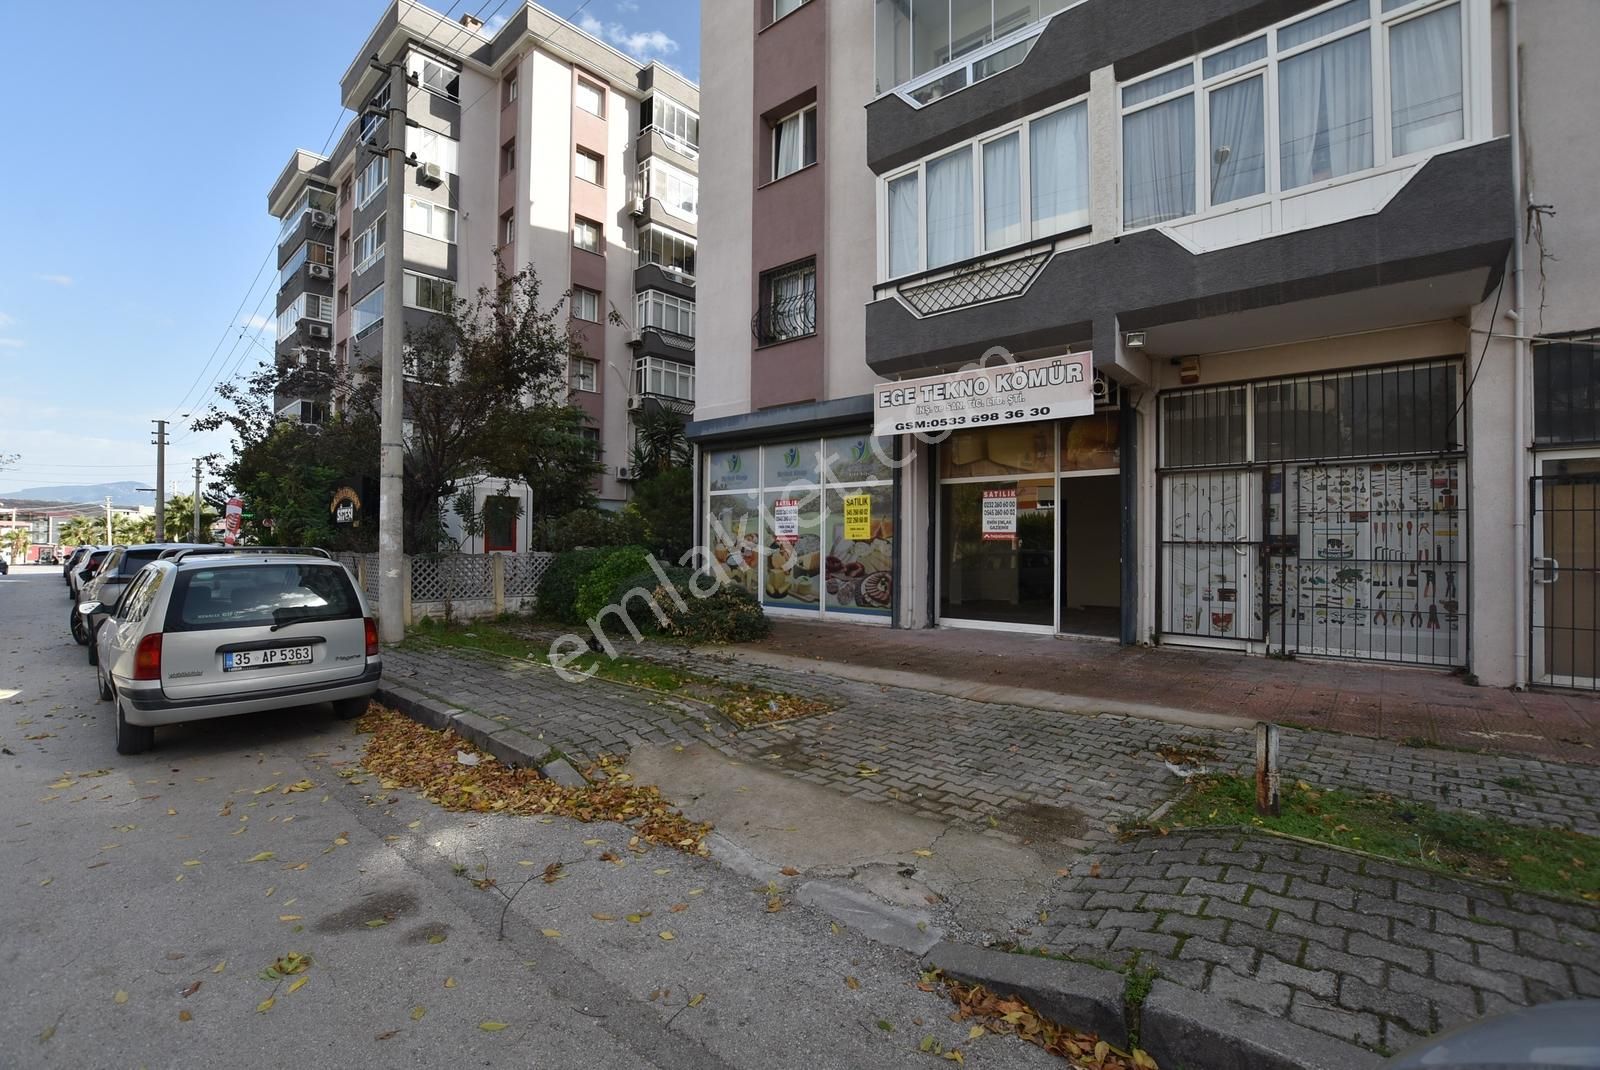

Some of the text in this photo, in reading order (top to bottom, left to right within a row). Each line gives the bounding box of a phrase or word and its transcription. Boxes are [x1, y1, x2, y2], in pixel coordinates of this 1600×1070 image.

[879, 360, 1084, 408] EGE TEKNO KÖMÜR
[895, 406, 1051, 431] GSM:0533 698 36 30
[235, 647, 310, 666] 35 AP 5363
